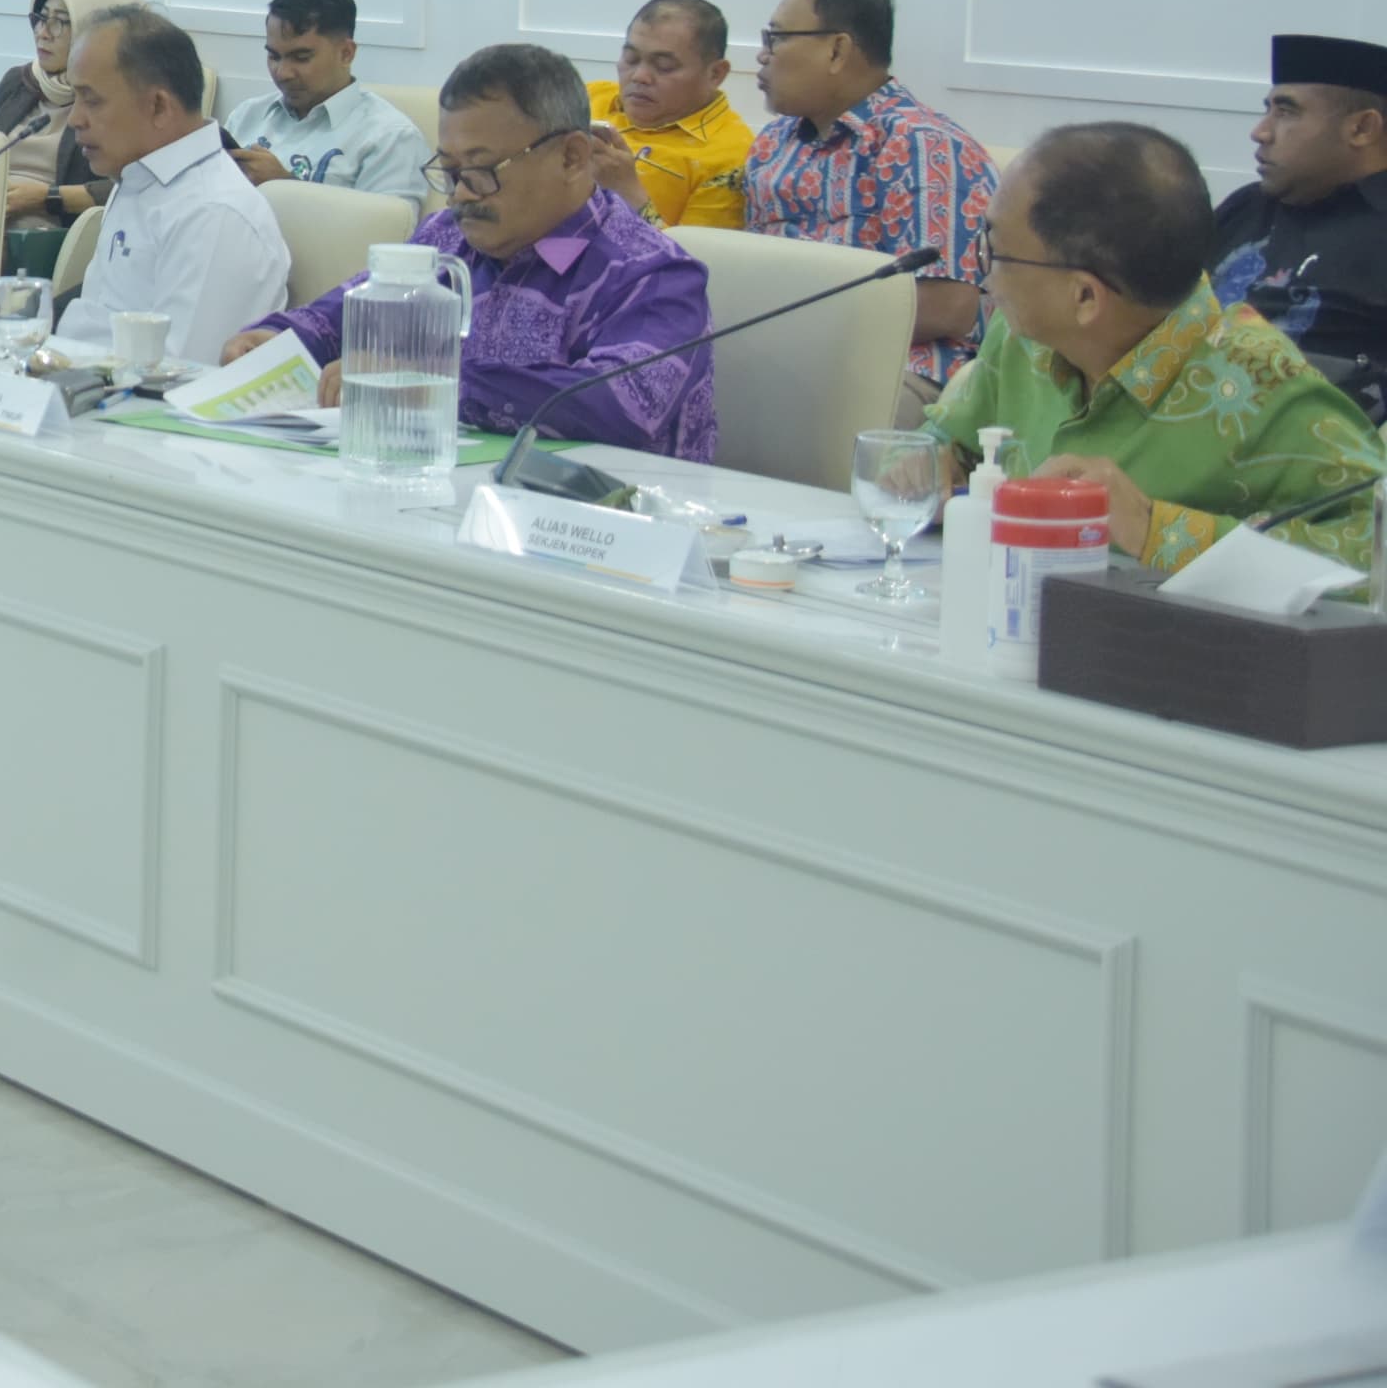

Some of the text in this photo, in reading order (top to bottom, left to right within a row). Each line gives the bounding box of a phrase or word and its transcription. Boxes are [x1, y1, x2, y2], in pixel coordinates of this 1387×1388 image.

[527, 533, 568, 552] SEKJEN
[531, 516, 615, 546] ALIAS WELLO
